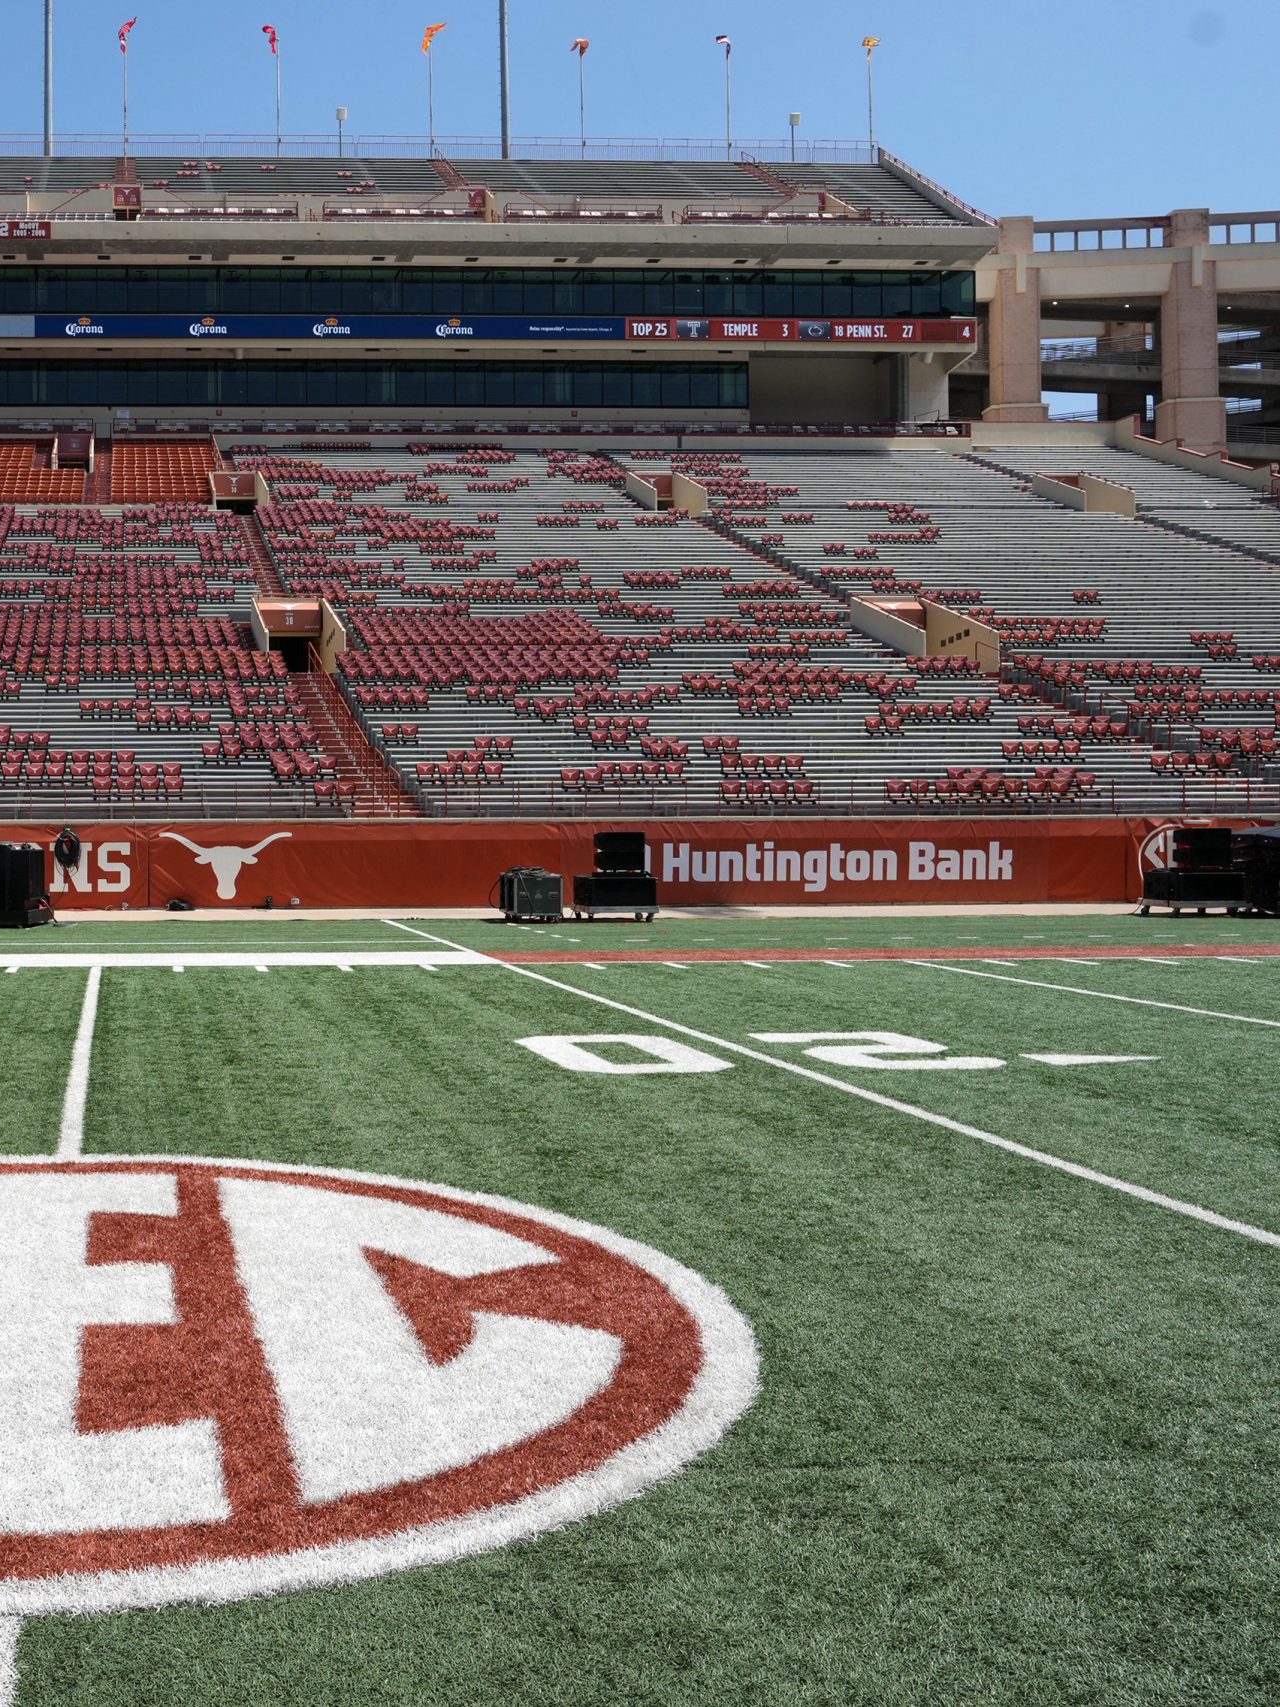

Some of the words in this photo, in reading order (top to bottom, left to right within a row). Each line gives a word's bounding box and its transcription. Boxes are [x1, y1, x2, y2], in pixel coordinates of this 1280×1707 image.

[65, 323, 104, 336] Corona
[189, 323, 228, 336] Corona
[312, 323, 351, 337] Corona
[435, 324, 474, 338] Corona
[632, 323, 651, 336] TOP
[654, 323, 668, 336] 25
[722, 324, 758, 336] TEMPLE
[782, 324, 788, 337] 3
[834, 325, 844, 337] 18
[846, 324, 872, 338] PENN
[874, 324, 888, 338] ST.
[902, 324, 914, 338] 27
[962, 325, 970, 338] 4
[662, 841, 898, 892] Huntington
[908, 841, 1013, 881] Bank
